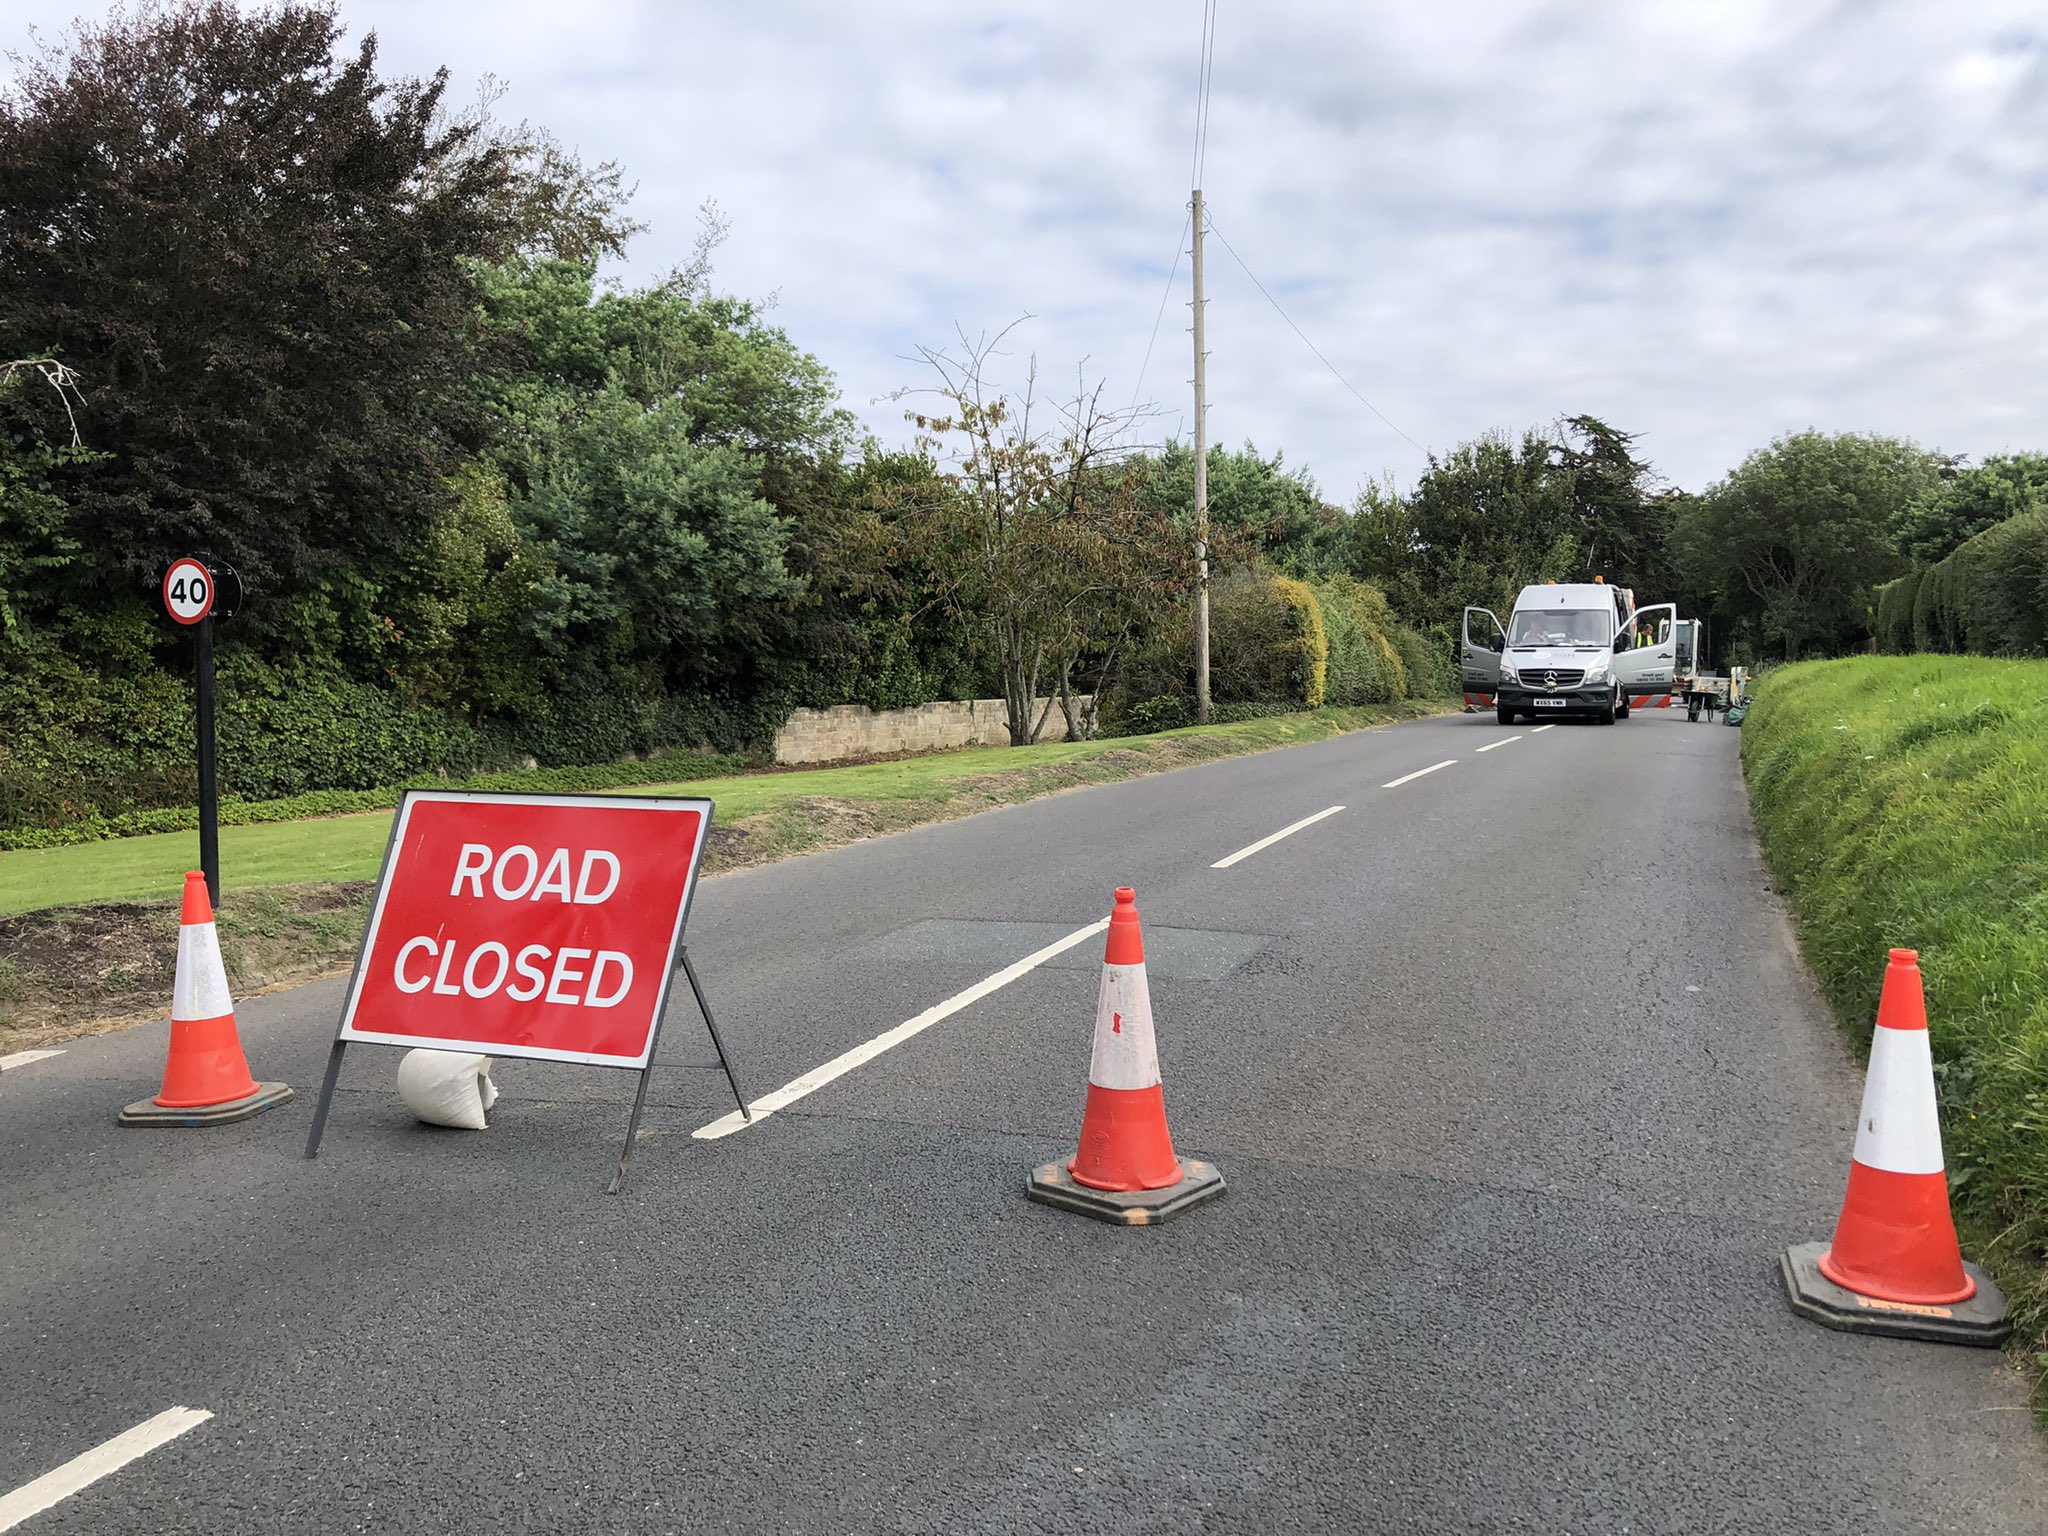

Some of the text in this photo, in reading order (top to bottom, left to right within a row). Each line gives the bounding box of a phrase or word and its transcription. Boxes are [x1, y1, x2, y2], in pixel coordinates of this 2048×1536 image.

[171, 577, 207, 604] 40
[449, 843, 621, 905] ROAD
[393, 936, 634, 1008] CLOSED
